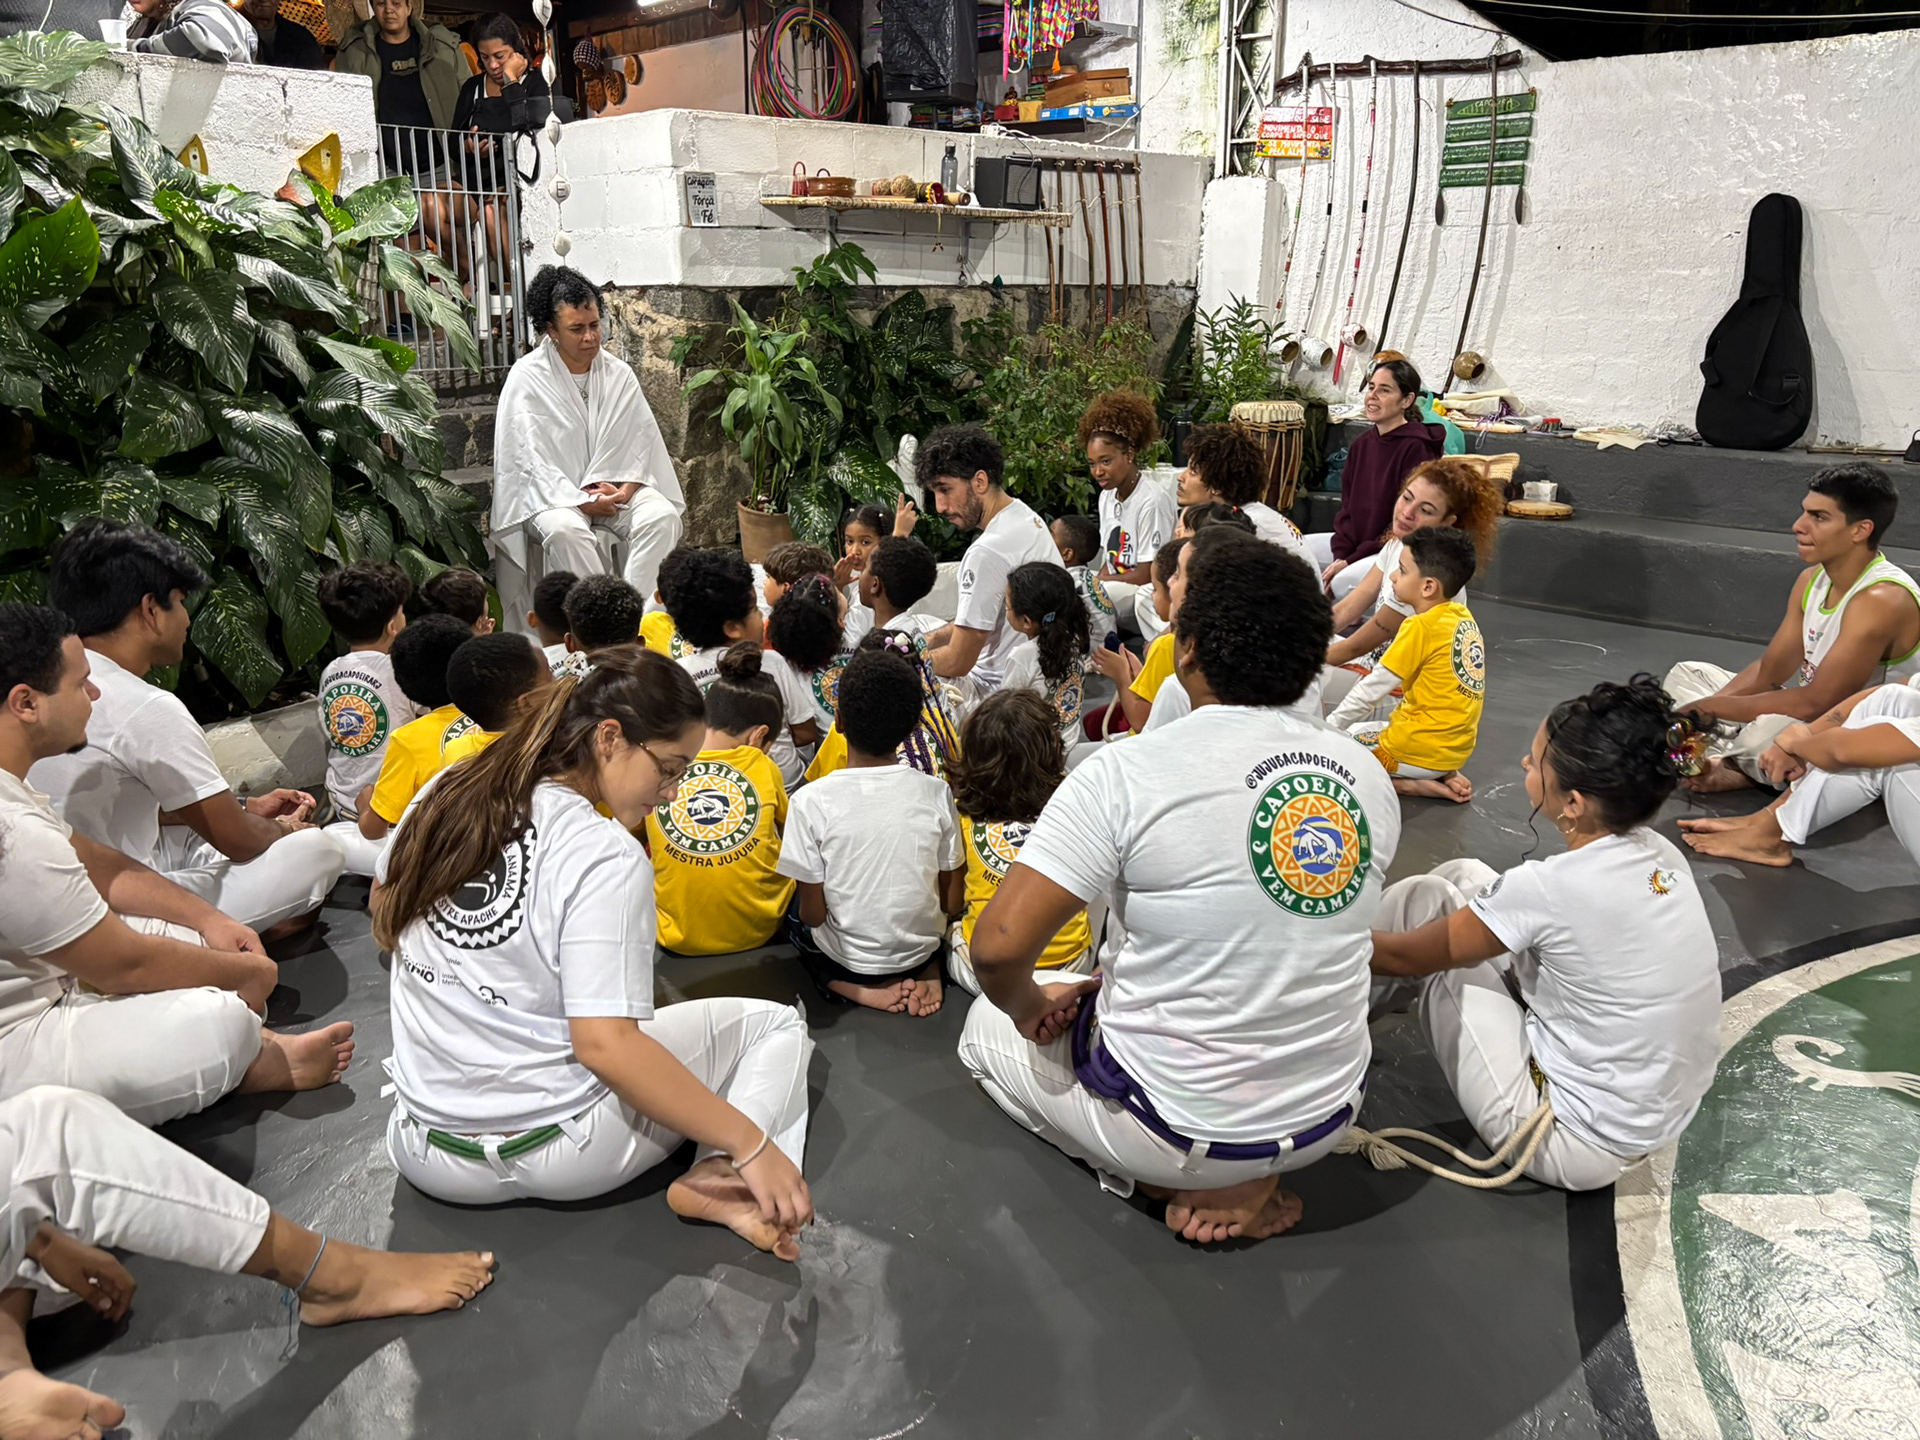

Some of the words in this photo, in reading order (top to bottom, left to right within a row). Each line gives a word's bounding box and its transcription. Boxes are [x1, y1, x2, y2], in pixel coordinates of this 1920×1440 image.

[692, 195, 714, 208] Força
[701, 209, 713, 223] Fé
[1245, 752, 1356, 789] @JUJUBACAPOEIRARJ
[1256, 776, 1362, 829] CAPOEIRA
[665, 821, 693, 848] VEM
[664, 843, 713, 867] MESTRA
[718, 837, 760, 866] JUJUBA
[983, 846, 1010, 872] VEM
[1261, 864, 1297, 907] VEM
[437, 898, 459, 921] STRE
[460, 905, 498, 925] APACHE
